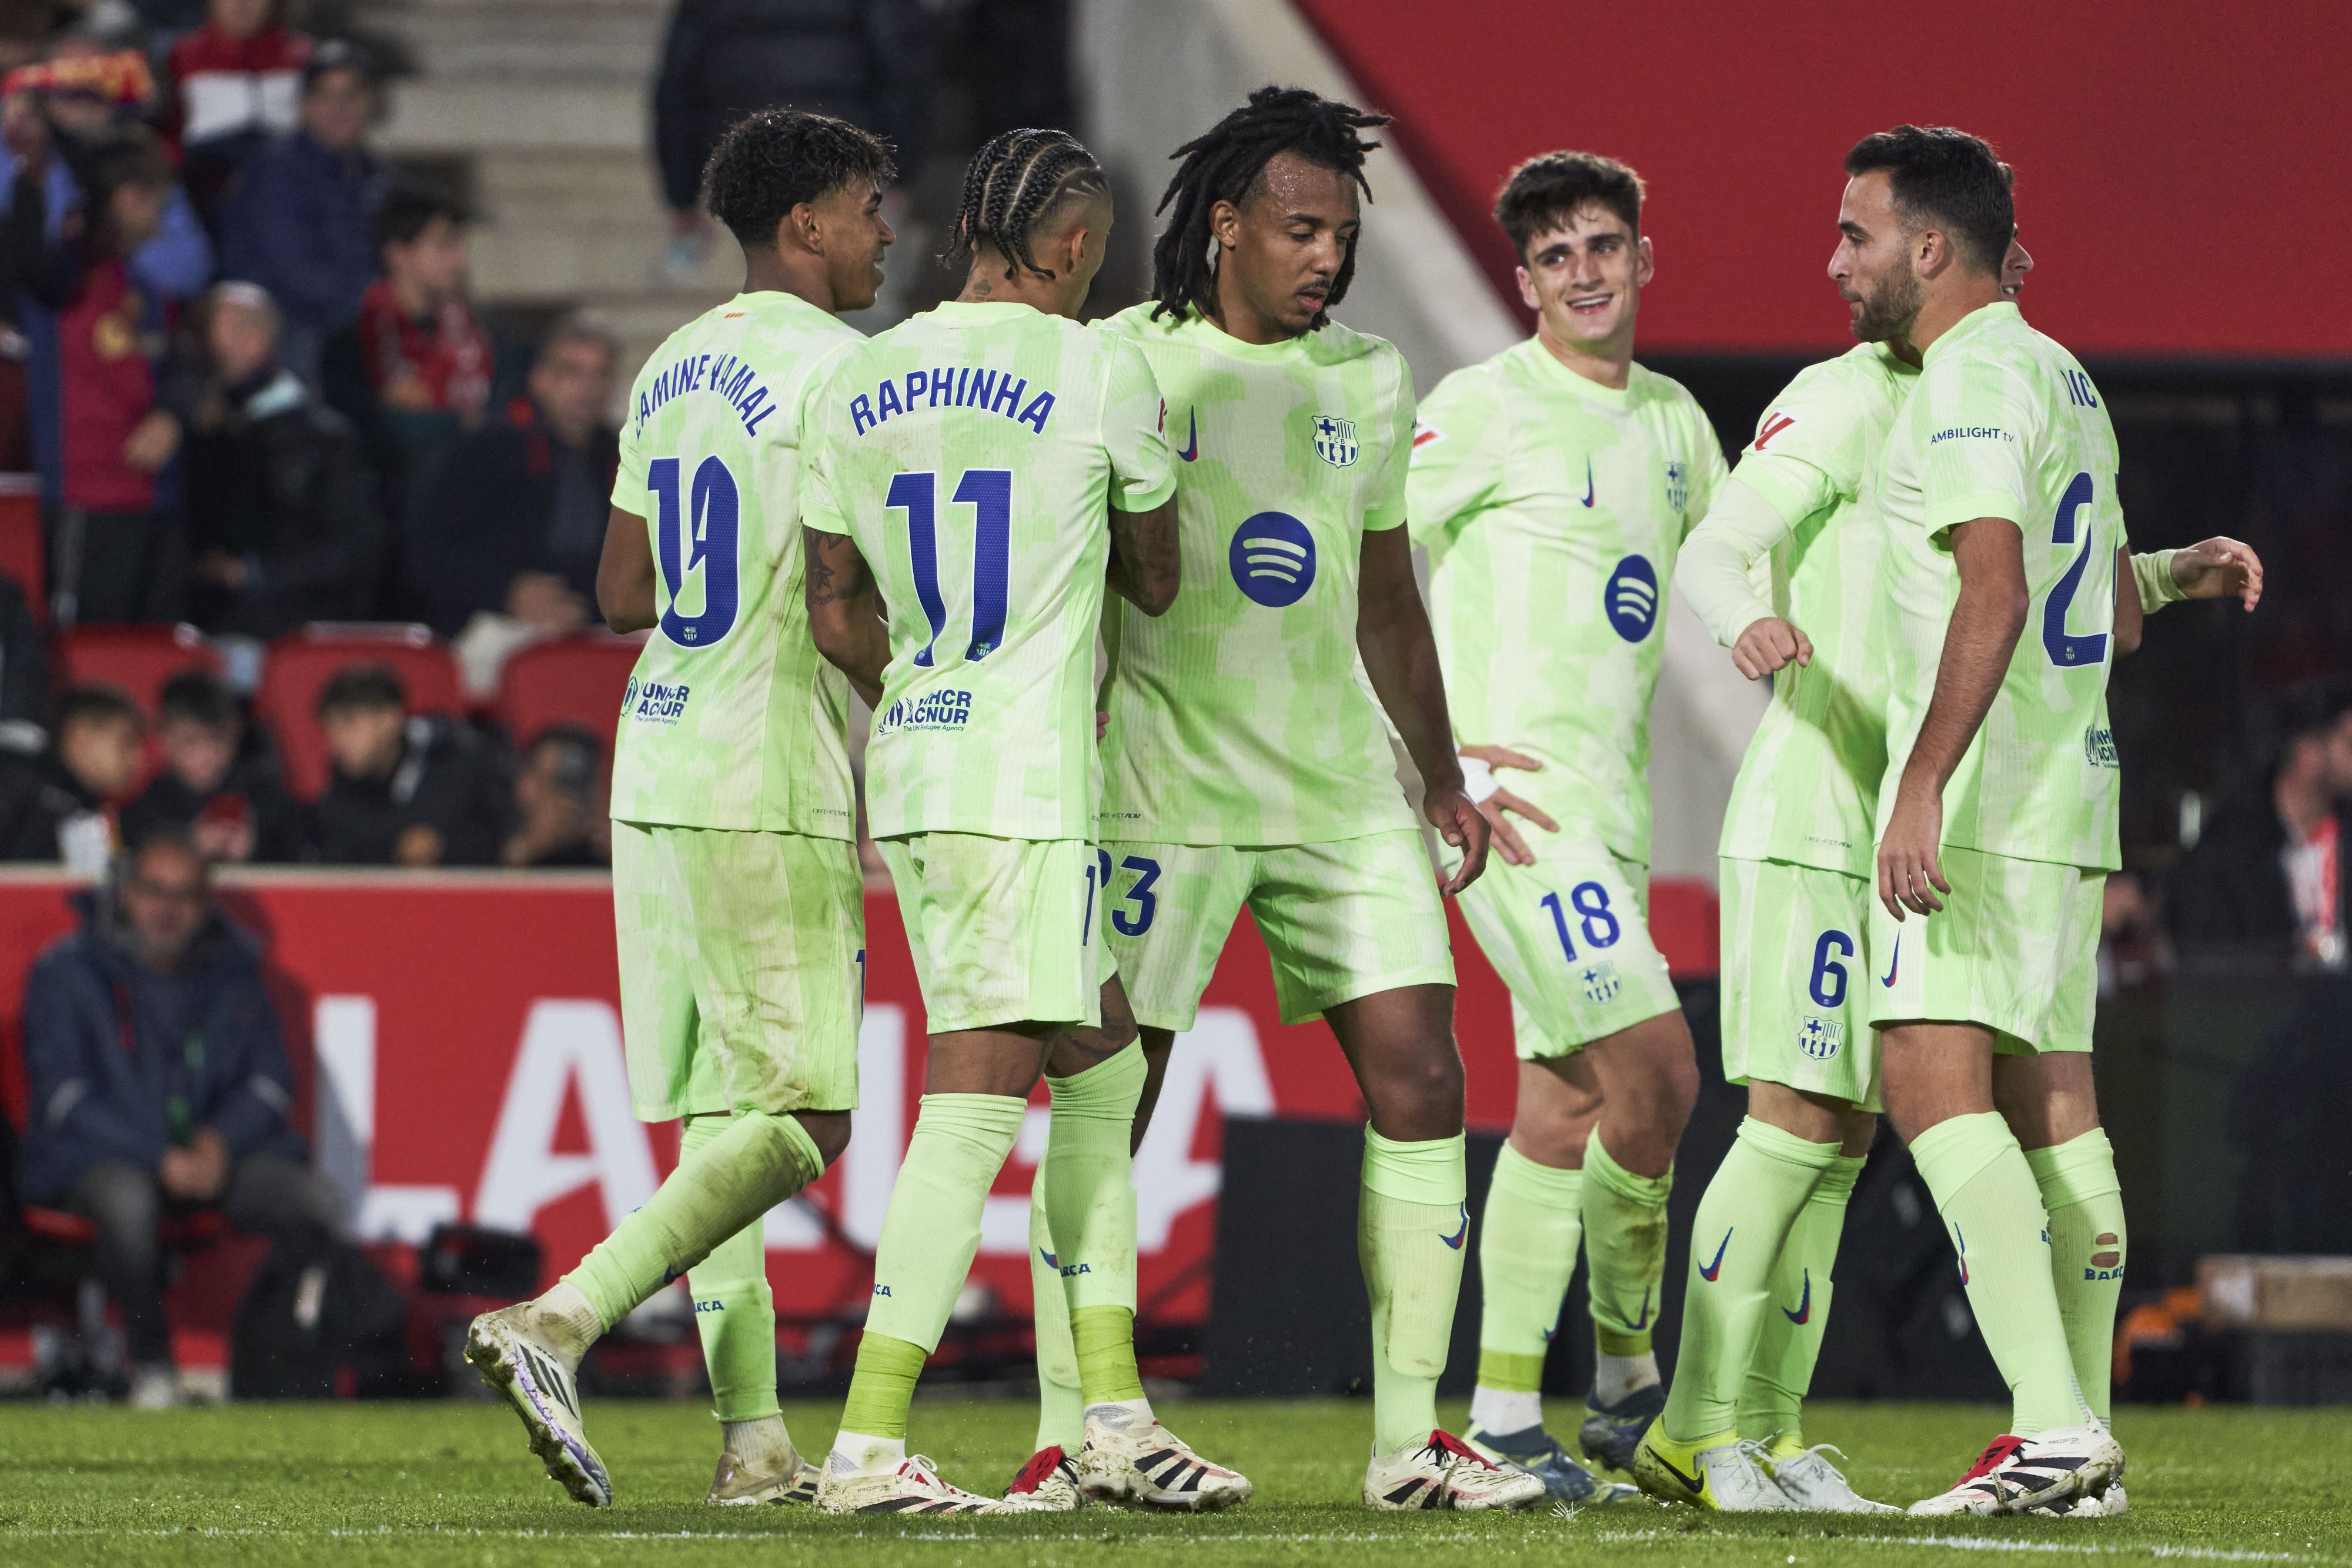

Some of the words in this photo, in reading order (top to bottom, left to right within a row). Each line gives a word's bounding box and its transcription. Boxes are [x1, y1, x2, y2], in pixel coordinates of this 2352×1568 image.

[710, 353, 777, 437] YAMAL
[850, 367, 1057, 437] RAPHINHA
[1931, 427, 2001, 445] AMBILIGHT
[2003, 431, 2014, 442] tv
[647, 455, 739, 647] 19
[886, 469, 1013, 667] 11
[1540, 881, 1621, 962] 18
[1809, 929, 1855, 1008] 6
